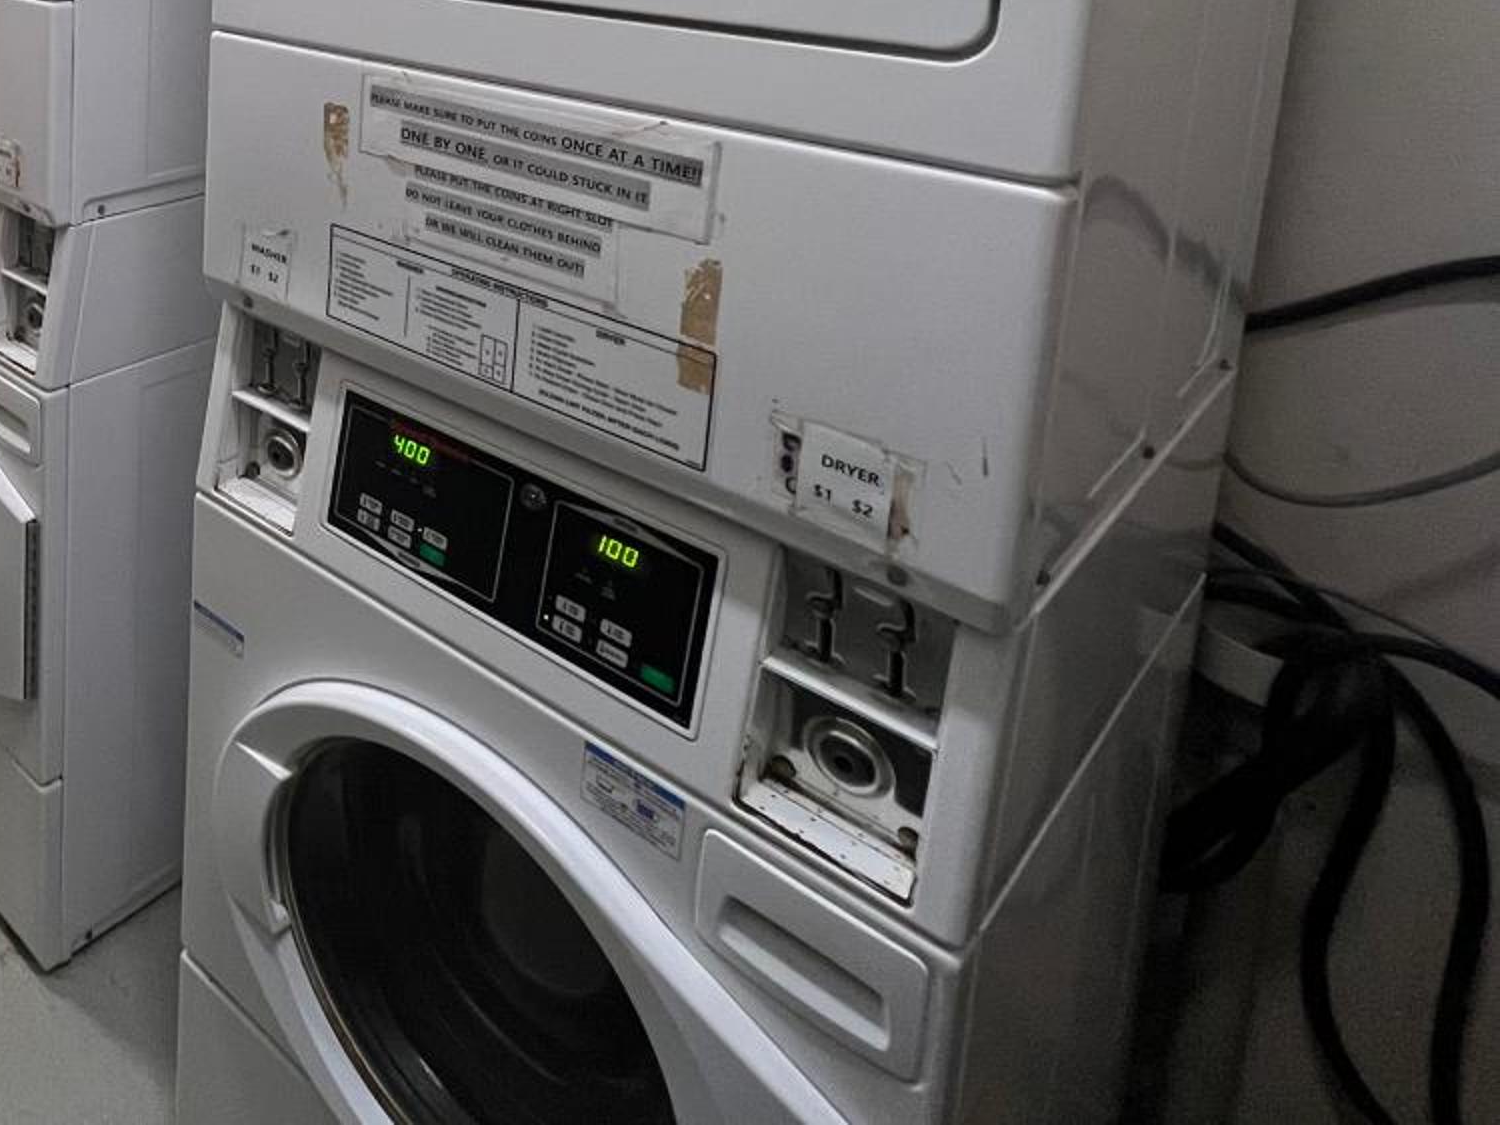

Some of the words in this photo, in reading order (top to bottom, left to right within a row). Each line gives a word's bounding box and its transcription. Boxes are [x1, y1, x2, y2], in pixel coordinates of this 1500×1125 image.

[404, 101, 430, 115] MAKE
[433, 107, 457, 121] SURE
[461, 114, 474, 125] TO
[478, 118, 496, 130] PUT
[501, 124, 519, 138] THE
[523, 130, 557, 146] COINS
[561, 136, 604, 157] ONCE
[608, 148, 628, 162] AT
[633, 154, 644, 168] A
[401, 127, 428, 145] ONE
[434, 136, 451, 149] BY
[493, 154, 509, 166] OR
[513, 160, 524, 170] IT
[527, 163, 568, 183] COULD
[572, 174, 612, 193] STUCK
[617, 186, 631, 200] IN
[636, 192, 648, 204] IT
[451, 174, 469, 187] PUT
[472, 180, 490, 193] THE
[495, 186, 527, 204] COINS
[529, 195, 545, 208] AT
[547, 200, 582, 219] RIGHT
[585, 211, 613, 228] SLOT
[406, 187, 419, 200] DO
[421, 191, 441, 207] NOT
[477, 207, 503, 224] YOUR
[508, 217, 553, 239] CLOTHES
[557, 232, 601, 253] BEHIND
[486, 237, 520, 255] CLEAN
[523, 246, 553, 264] THEM
[394, 434, 431, 466] 400
[821, 454, 880, 487] DRYER
[814, 484, 832, 501] $1
[852, 499, 873, 517] $2
[599, 535, 639, 568] 100
